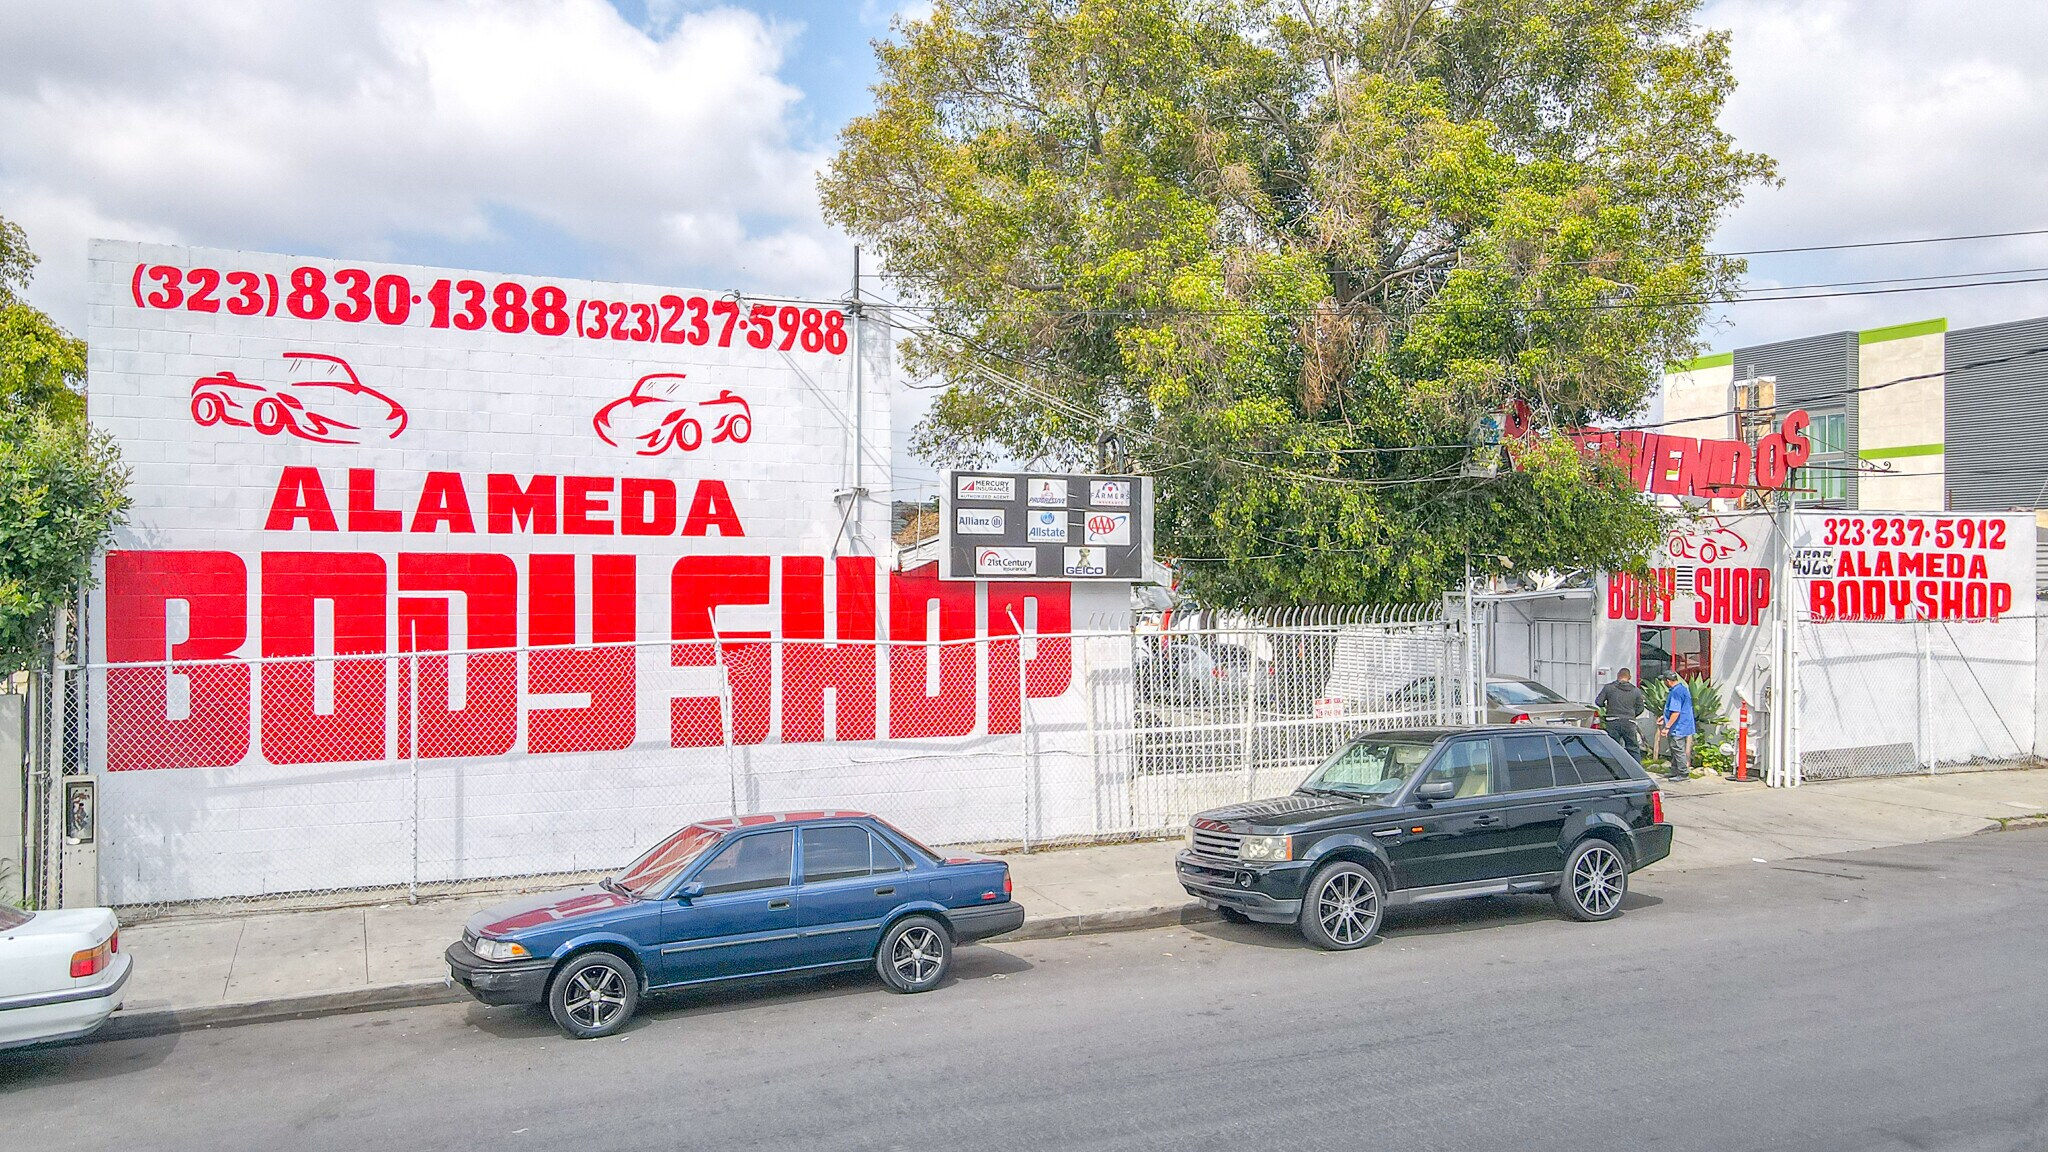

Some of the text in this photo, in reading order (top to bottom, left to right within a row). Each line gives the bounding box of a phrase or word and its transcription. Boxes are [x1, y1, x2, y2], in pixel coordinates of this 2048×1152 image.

[264, 465, 746, 537] ALAMEDA
[959, 516, 990, 526] Allianz
[1090, 516, 1114, 535] AAA
[1029, 527, 1066, 538] Allstate
[987, 558, 1033, 568] 21st Century
[1065, 566, 1104, 575] GEICO
[1836, 550, 1989, 579] ALAMEDA
[1607, 566, 1771, 626] BODY SHOP
[105, 549, 1072, 772] BODY SHOP
